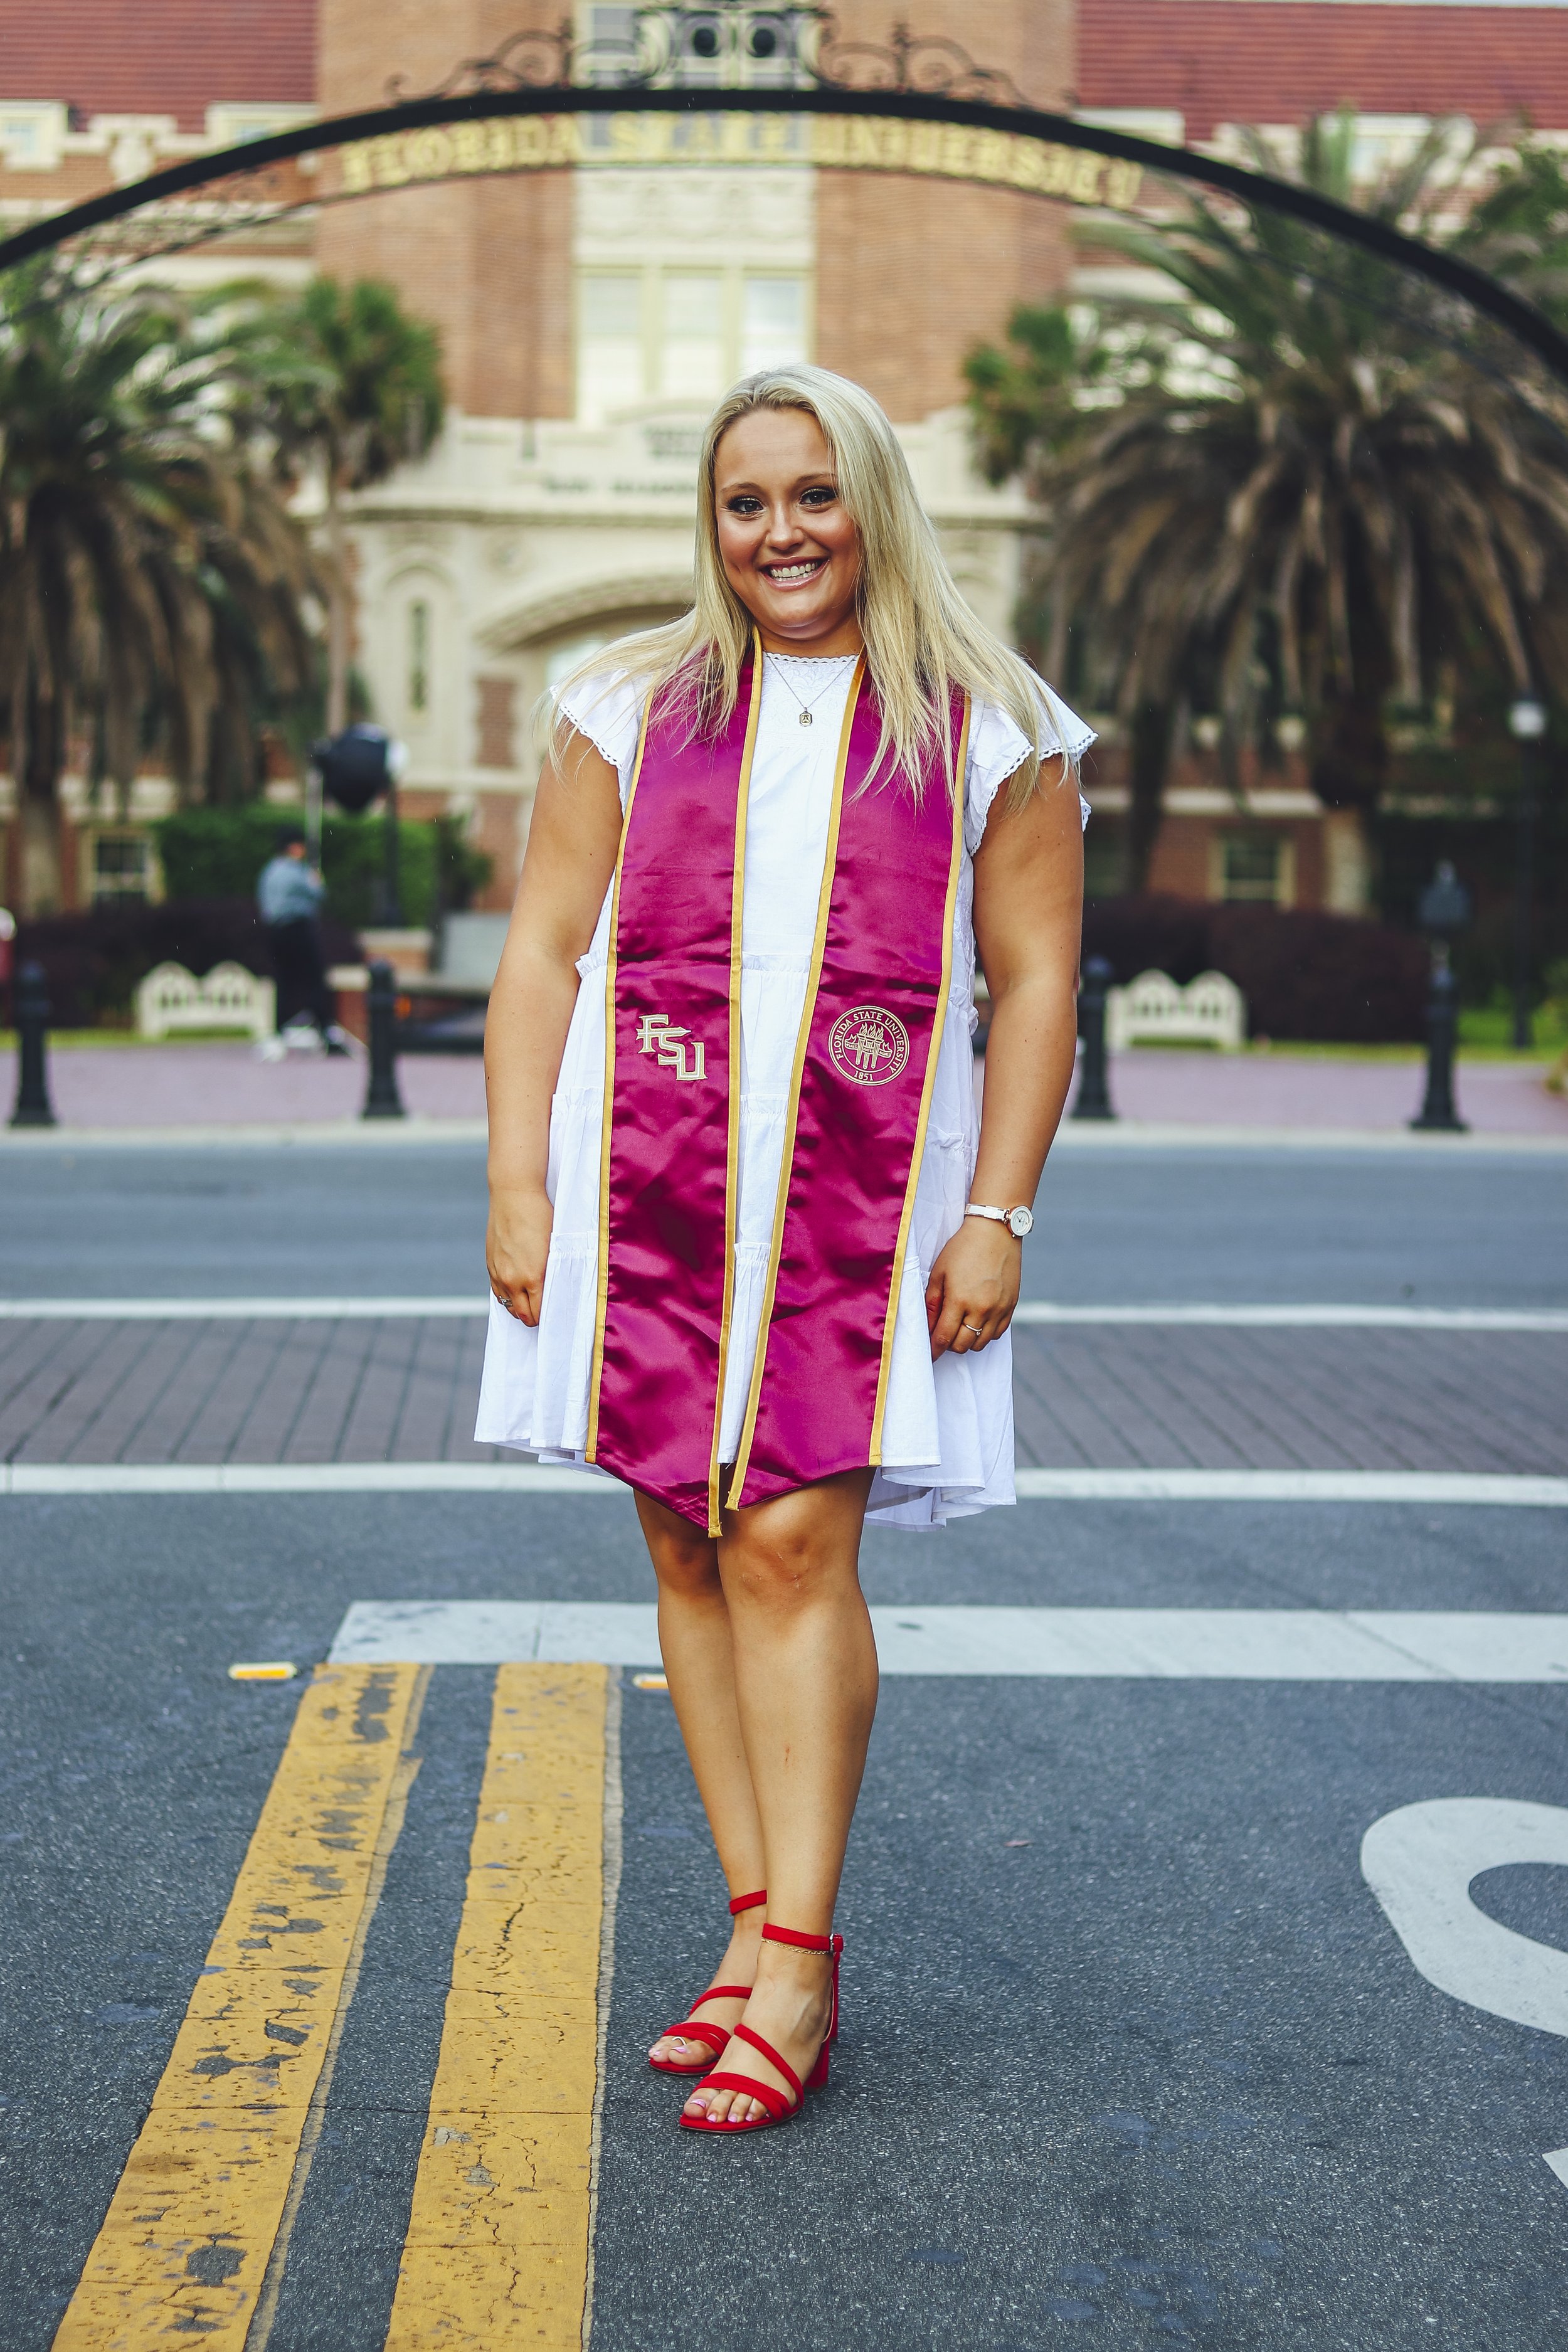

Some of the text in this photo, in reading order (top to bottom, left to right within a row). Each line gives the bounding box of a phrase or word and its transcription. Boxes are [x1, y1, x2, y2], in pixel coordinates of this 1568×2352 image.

[342, 114, 583, 191] FLORIDA
[610, 110, 787, 163] STATE
[636, 1014, 708, 1080] FSU
[834, 1011, 904, 1073] FLORIDA STATE UNIVERSITY
[854, 1071, 873, 1081] 1851
